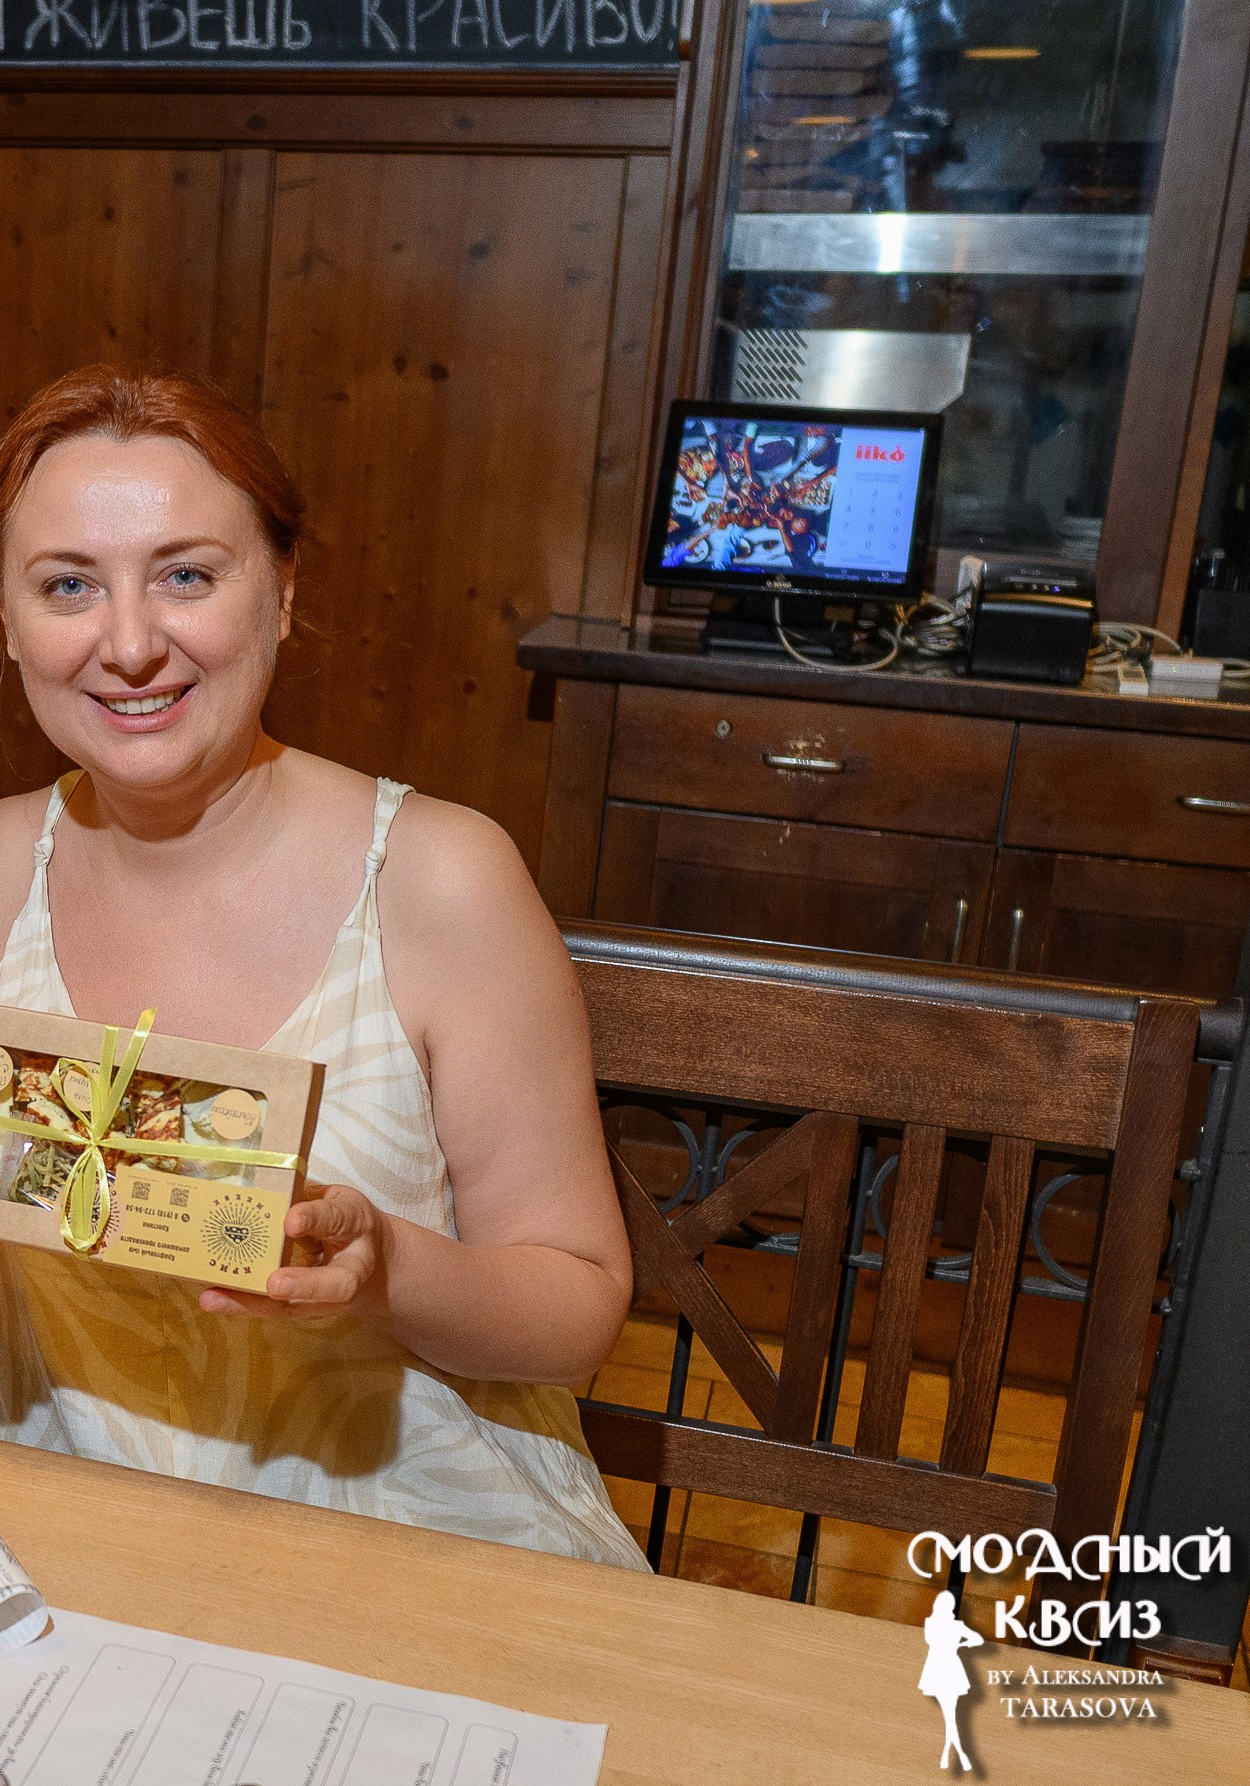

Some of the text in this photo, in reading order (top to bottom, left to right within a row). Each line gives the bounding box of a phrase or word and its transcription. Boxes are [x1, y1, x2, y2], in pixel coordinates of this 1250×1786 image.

[855, 444, 905, 462] iiko
[142, 1221, 169, 1232] Кристина
[128, 1246, 175, 1261] Крафтовый сыр
